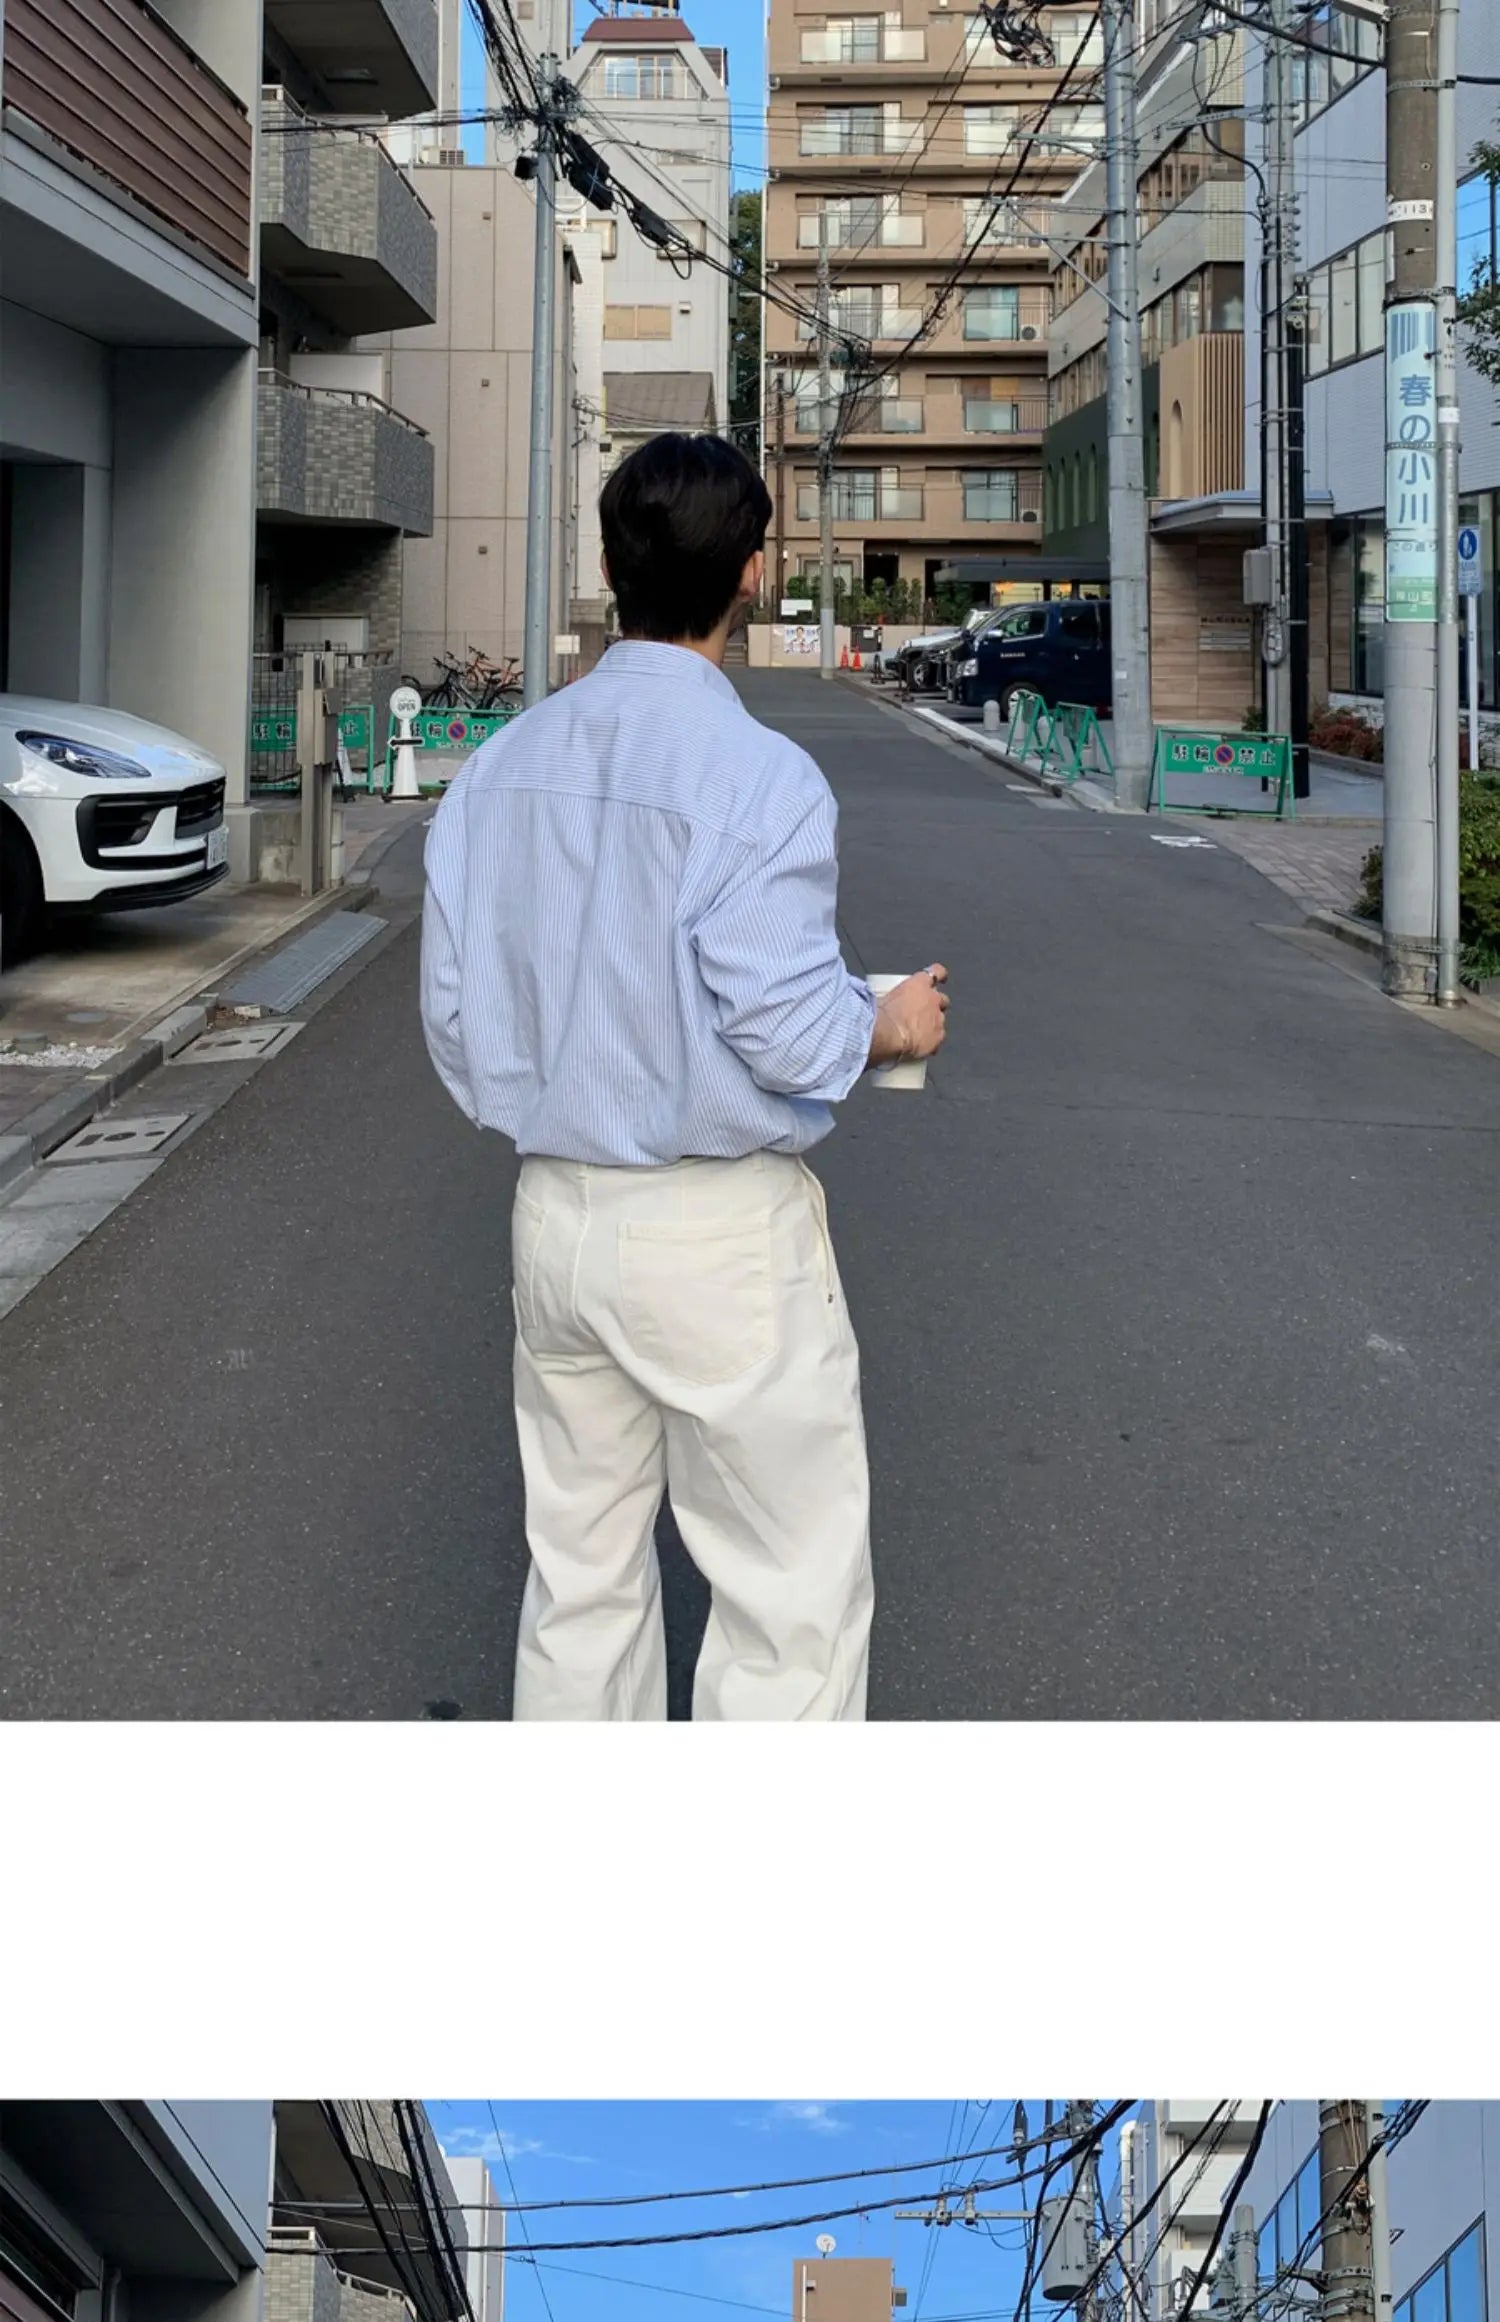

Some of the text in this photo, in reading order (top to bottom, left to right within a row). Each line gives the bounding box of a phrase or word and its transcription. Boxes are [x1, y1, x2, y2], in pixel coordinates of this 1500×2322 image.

[1399, 374, 1432, 524] 春の小川
[397, 702, 417, 712] OPEN
[1238, 746, 1276, 766] 禁止
